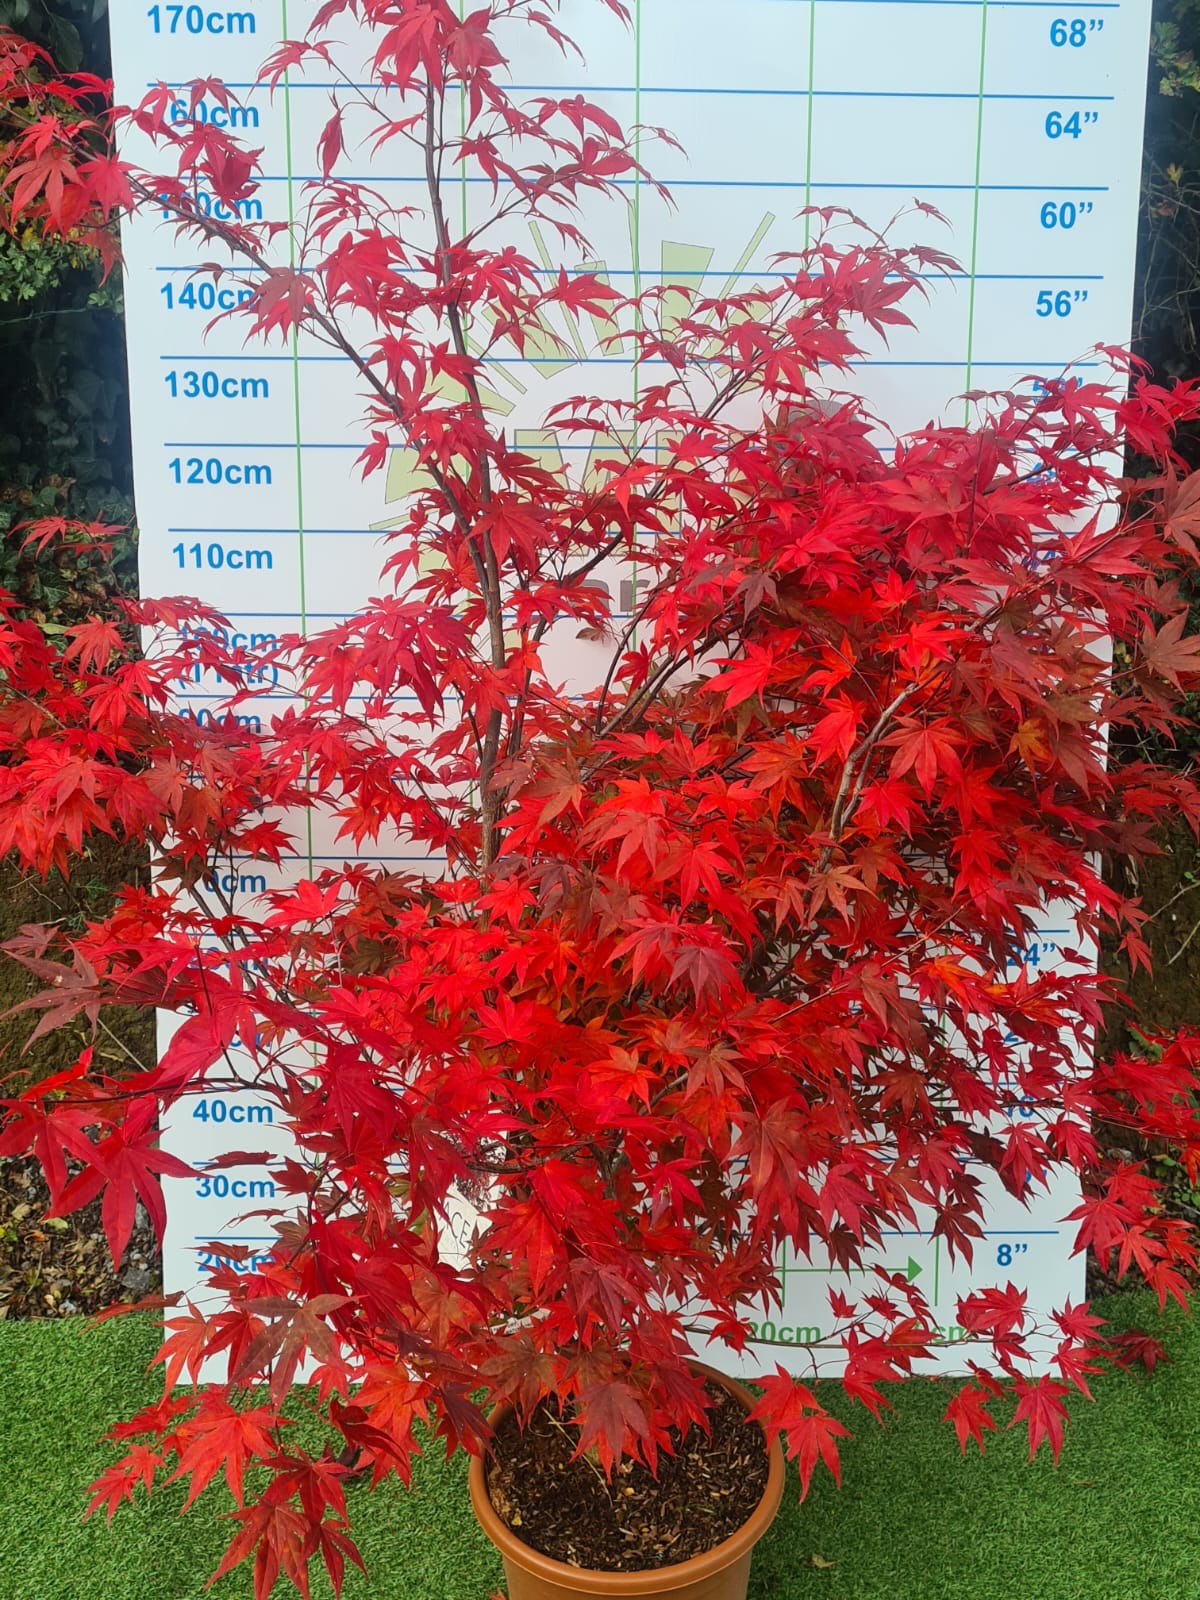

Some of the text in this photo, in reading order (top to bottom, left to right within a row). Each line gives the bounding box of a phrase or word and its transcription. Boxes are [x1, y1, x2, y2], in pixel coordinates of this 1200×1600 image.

[147, 5, 256, 34] 170cm
[152, 99, 259, 127] 60cm
[161, 191, 263, 219] 10cm
[165, 371, 269, 398] 130cm
[169, 458, 272, 484] 120cm
[173, 543, 273, 569] 110cm
[192, 1098, 273, 1123] 40cm
[195, 1175, 275, 1198] 30cm
